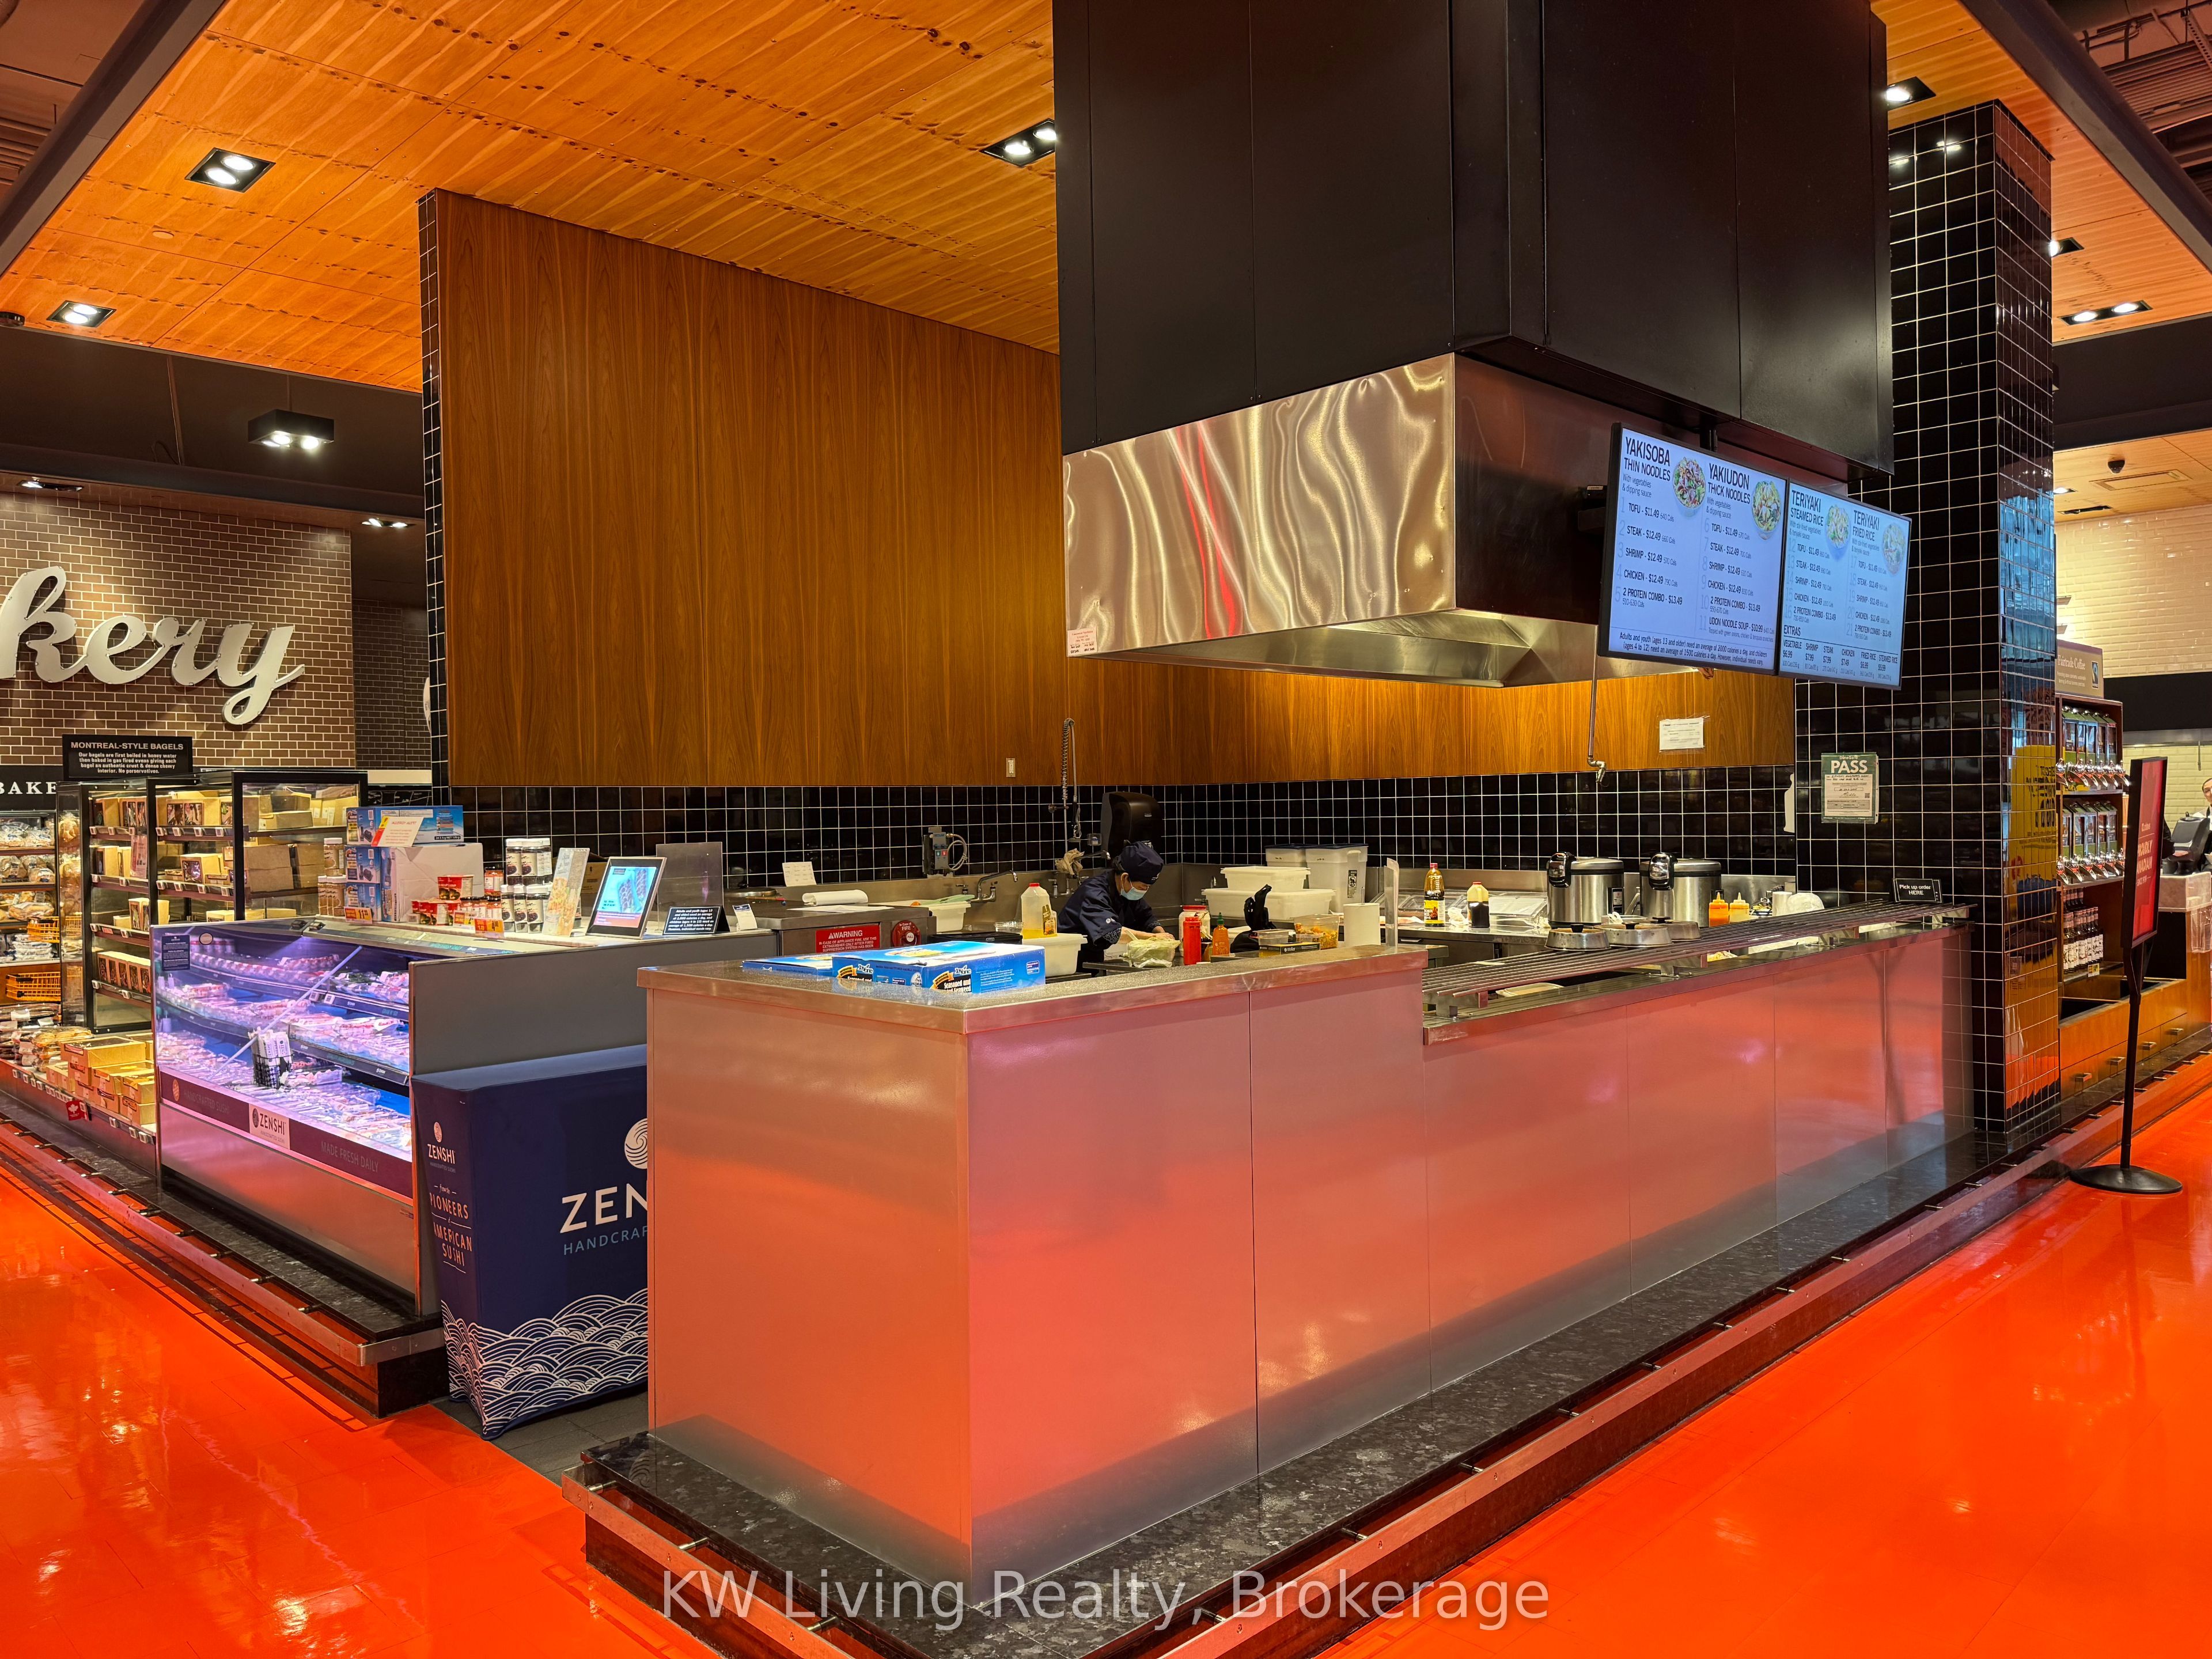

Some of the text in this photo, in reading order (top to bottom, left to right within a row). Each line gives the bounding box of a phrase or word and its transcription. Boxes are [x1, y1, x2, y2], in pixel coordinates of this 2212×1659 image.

[1626, 437, 1670, 467] YAKISOBA
[1624, 457, 1671, 482] THIN NOODLES
[1710, 463, 1749, 490] YAKIUDON
[1623, 473, 1652, 488] With vegetables
[1622, 483, 1625, 491] &
[1626, 485, 1640, 497] dipping
[1708, 482, 1751, 504] THICK NOODLES
[1792, 490, 1821, 513] TERIYAKI
[1629, 503, 1641, 513] TOFU
[1645, 507, 1659, 518] $11.49
[1791, 507, 1824, 526] STEAMED RICE
[1854, 510, 1880, 531] TERIYAKI
[1627, 526, 1642, 536] STEAK
[1646, 530, 1661, 541] $12.49
[1712, 524, 1738, 537] TOFU $11.49
[1853, 527, 1875, 541] FRIED RICE
[1626, 548, 1643, 559] SHRIMP
[1648, 552, 1662, 562] $12.49
[1710, 542, 1739, 556] STEAK $12.49
[1797, 544, 1819, 556] TOFU $11.49
[1709, 562, 1740, 575] SHRIMP $12.49
[1797, 560, 1820, 573] STEAK $12.49
[1624, 570, 1644, 581] CHICKEN
[1649, 574, 1663, 584] $12.49
[1796, 577, 1821, 589] SHRIMP $12.49
[1708, 580, 1741, 593] CHICKEN $12.49
[1623, 588, 1682, 605] 2 PROTEIN COMBO $13.49
[1794, 593, 1822, 605] CHICKEN $12.49
[1714, 597, 1730, 607] PROTEIN
[1732, 600, 1745, 609] COMBO
[1749, 603, 1760, 612] $13.49
[1797, 607, 1810, 616] PROTEIN
[1812, 609, 1823, 618] COMBO
[1710, 617, 1721, 626] UDON
[1722, 619, 1737, 628] NOODLE
[1738, 622, 1749, 630] SOUP
[1784, 625, 1801, 636] EXTRAS
[1620, 632, 1632, 640] Adults
[2058, 655, 2085, 670] Fairtrade Coffee
[1831, 760, 1868, 774] PASS
[834, 930, 863, 938] WARNING
[944, 980, 963, 989] Seasoned
[260, 1113, 285, 1135] ZENSHI
[321, 1142, 378, 1173] MADE FRESH DAILY
[427, 1143, 455, 1164] ZENSHI
